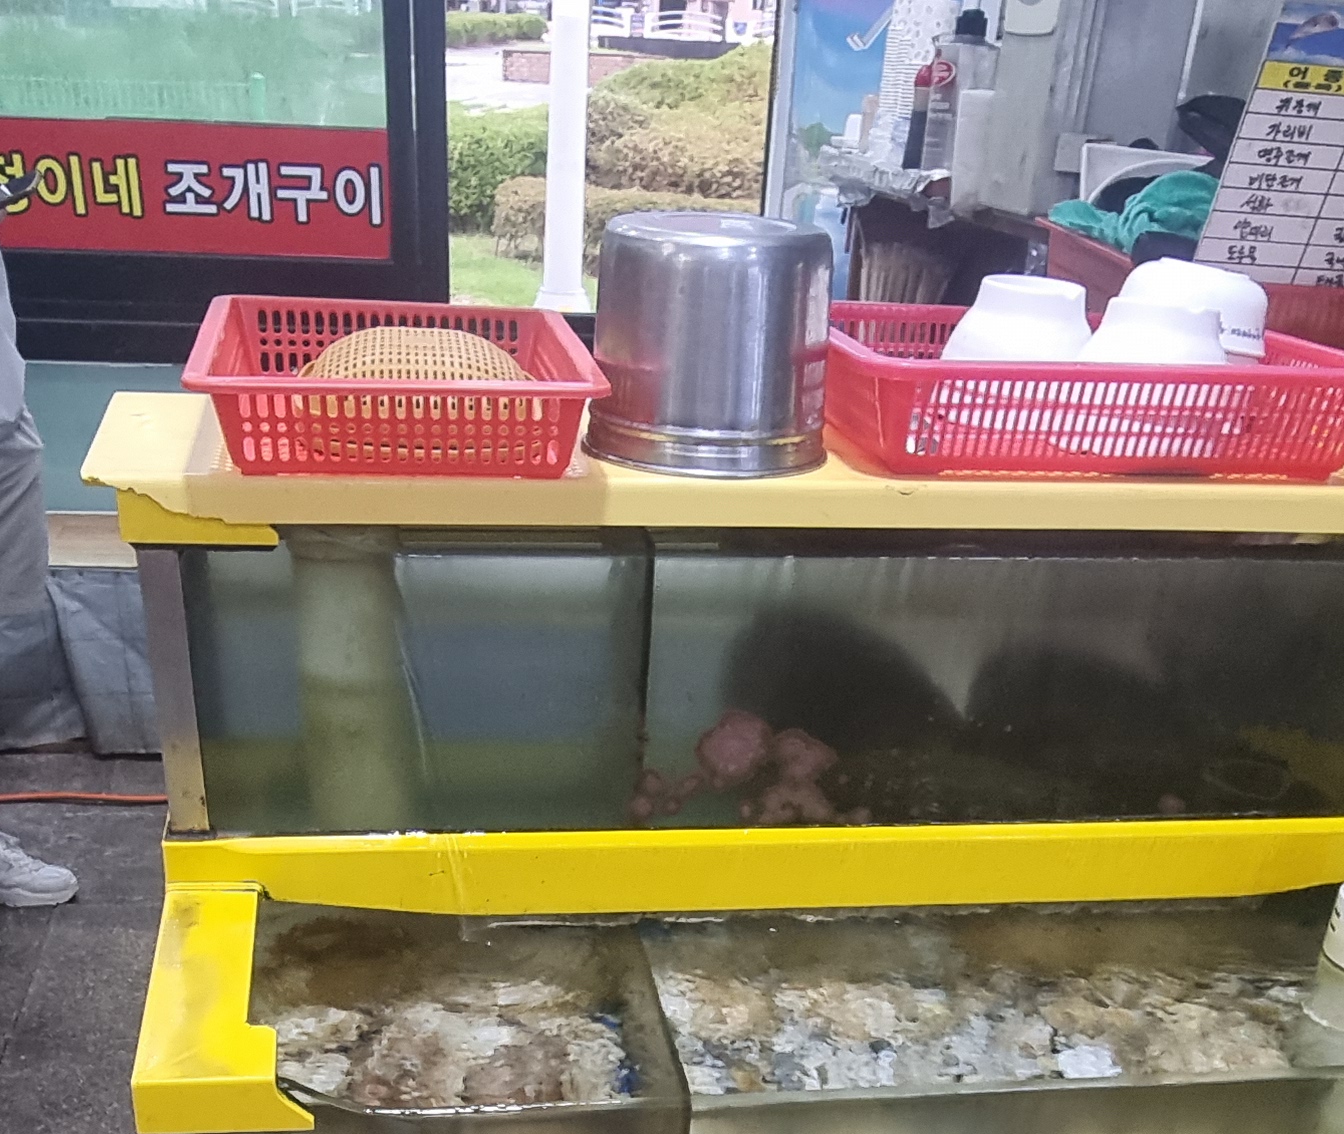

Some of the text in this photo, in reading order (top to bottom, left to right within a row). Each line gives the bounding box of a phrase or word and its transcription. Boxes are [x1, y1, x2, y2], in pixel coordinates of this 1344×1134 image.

[1288, 66, 1310, 81] 어
[1266, 122, 1313, 141] 가리비
[163, 159, 385, 227] 조개구이
